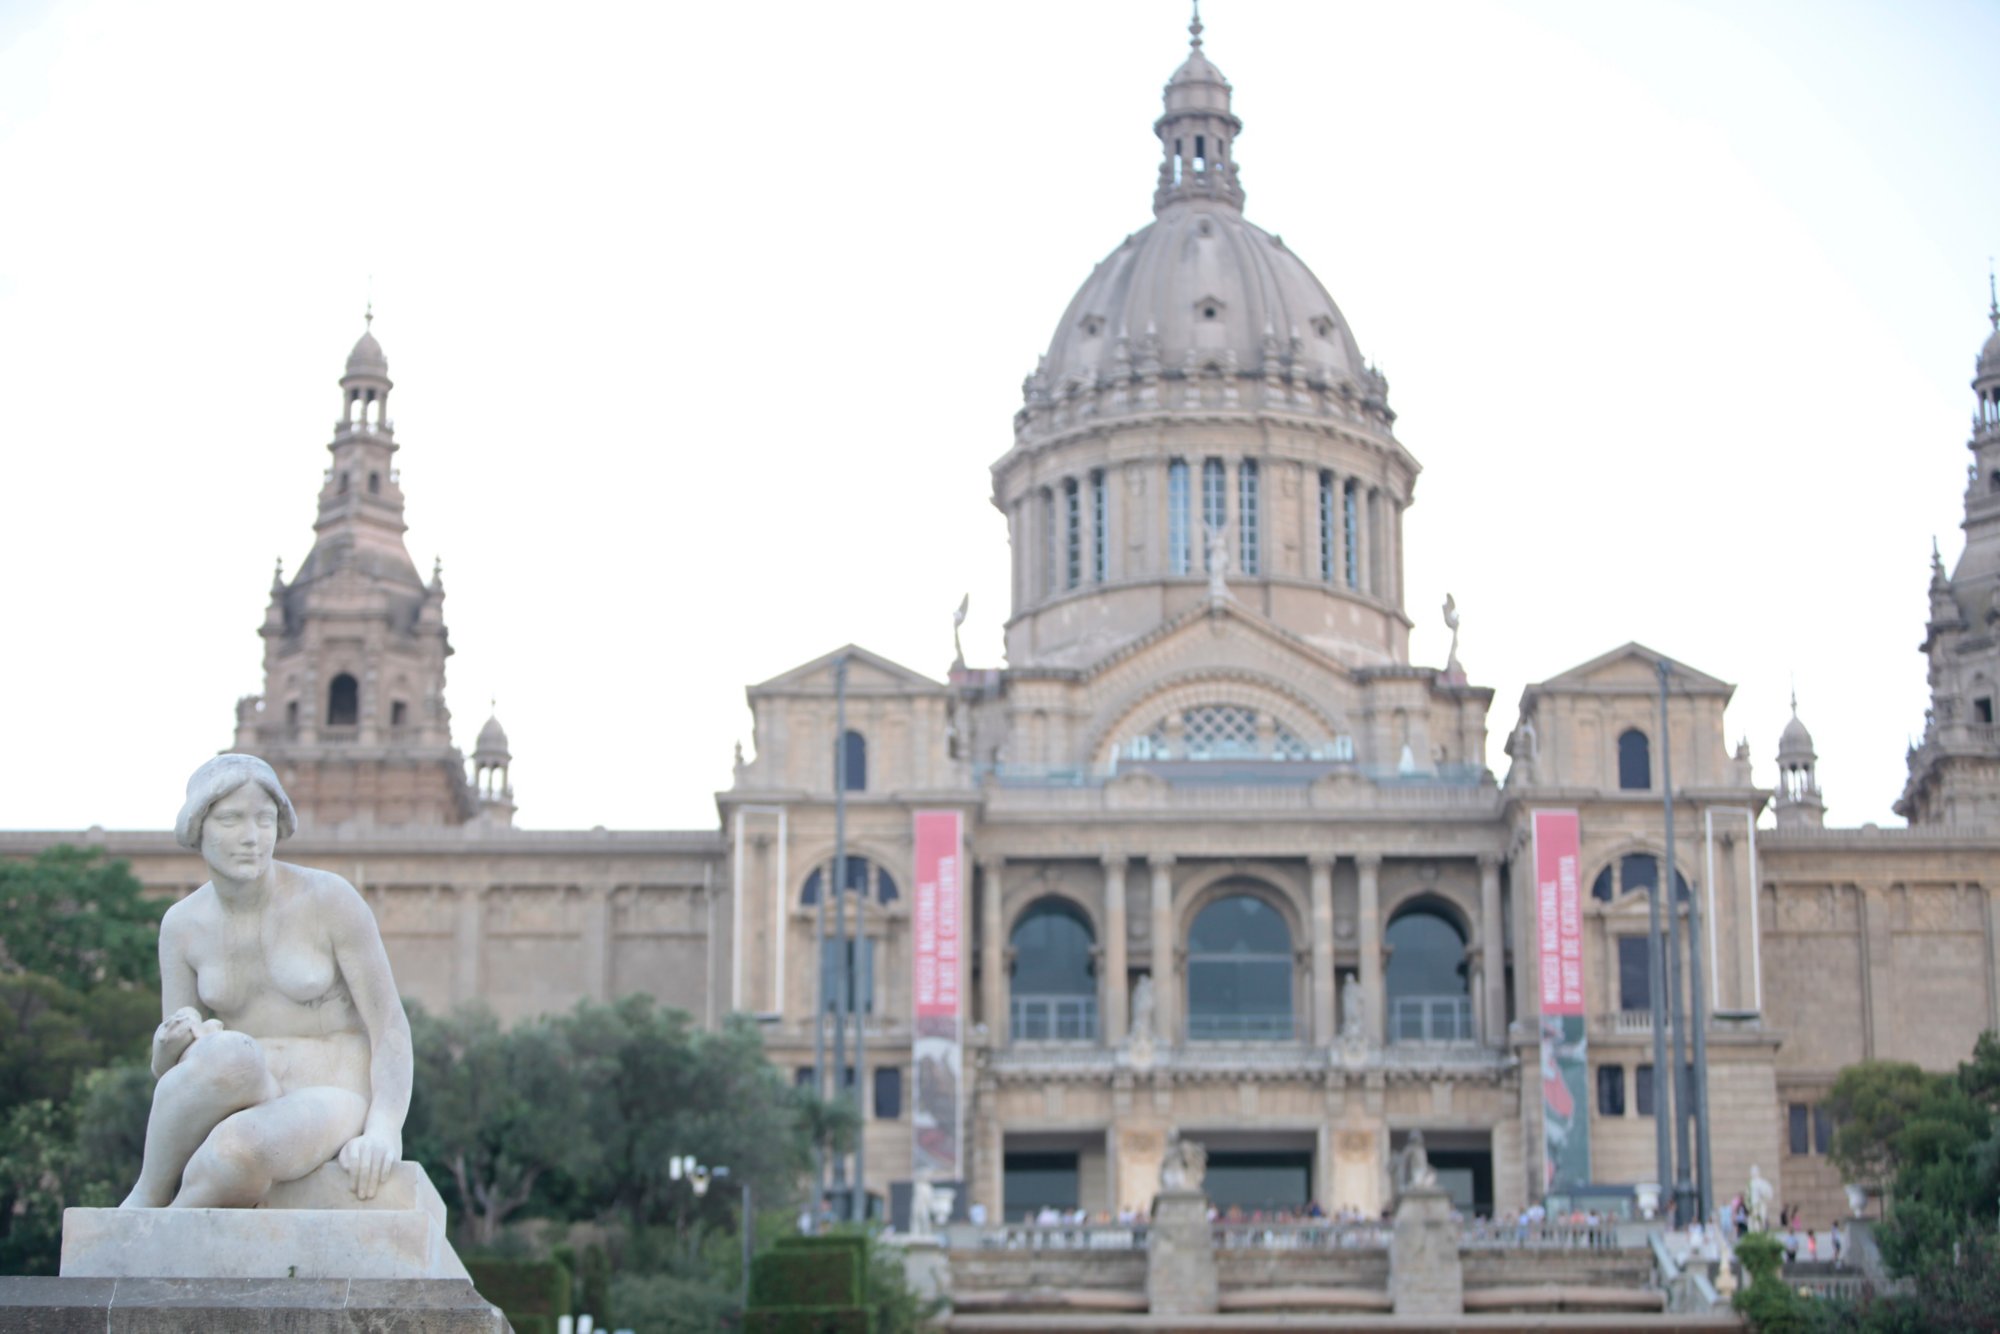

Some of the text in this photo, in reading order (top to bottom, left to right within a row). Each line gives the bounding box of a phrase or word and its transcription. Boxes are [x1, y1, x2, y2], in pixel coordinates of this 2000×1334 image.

[938, 856, 956, 936] CATALUNYA
[1559, 855, 1578, 935] CATALUNYA
[918, 882, 935, 1004] MUSEU NACIONAL
[938, 940, 956, 958] DE
[1540, 881, 1560, 1004] MUSEU NACIONAL
[1561, 939, 1579, 958] DE
